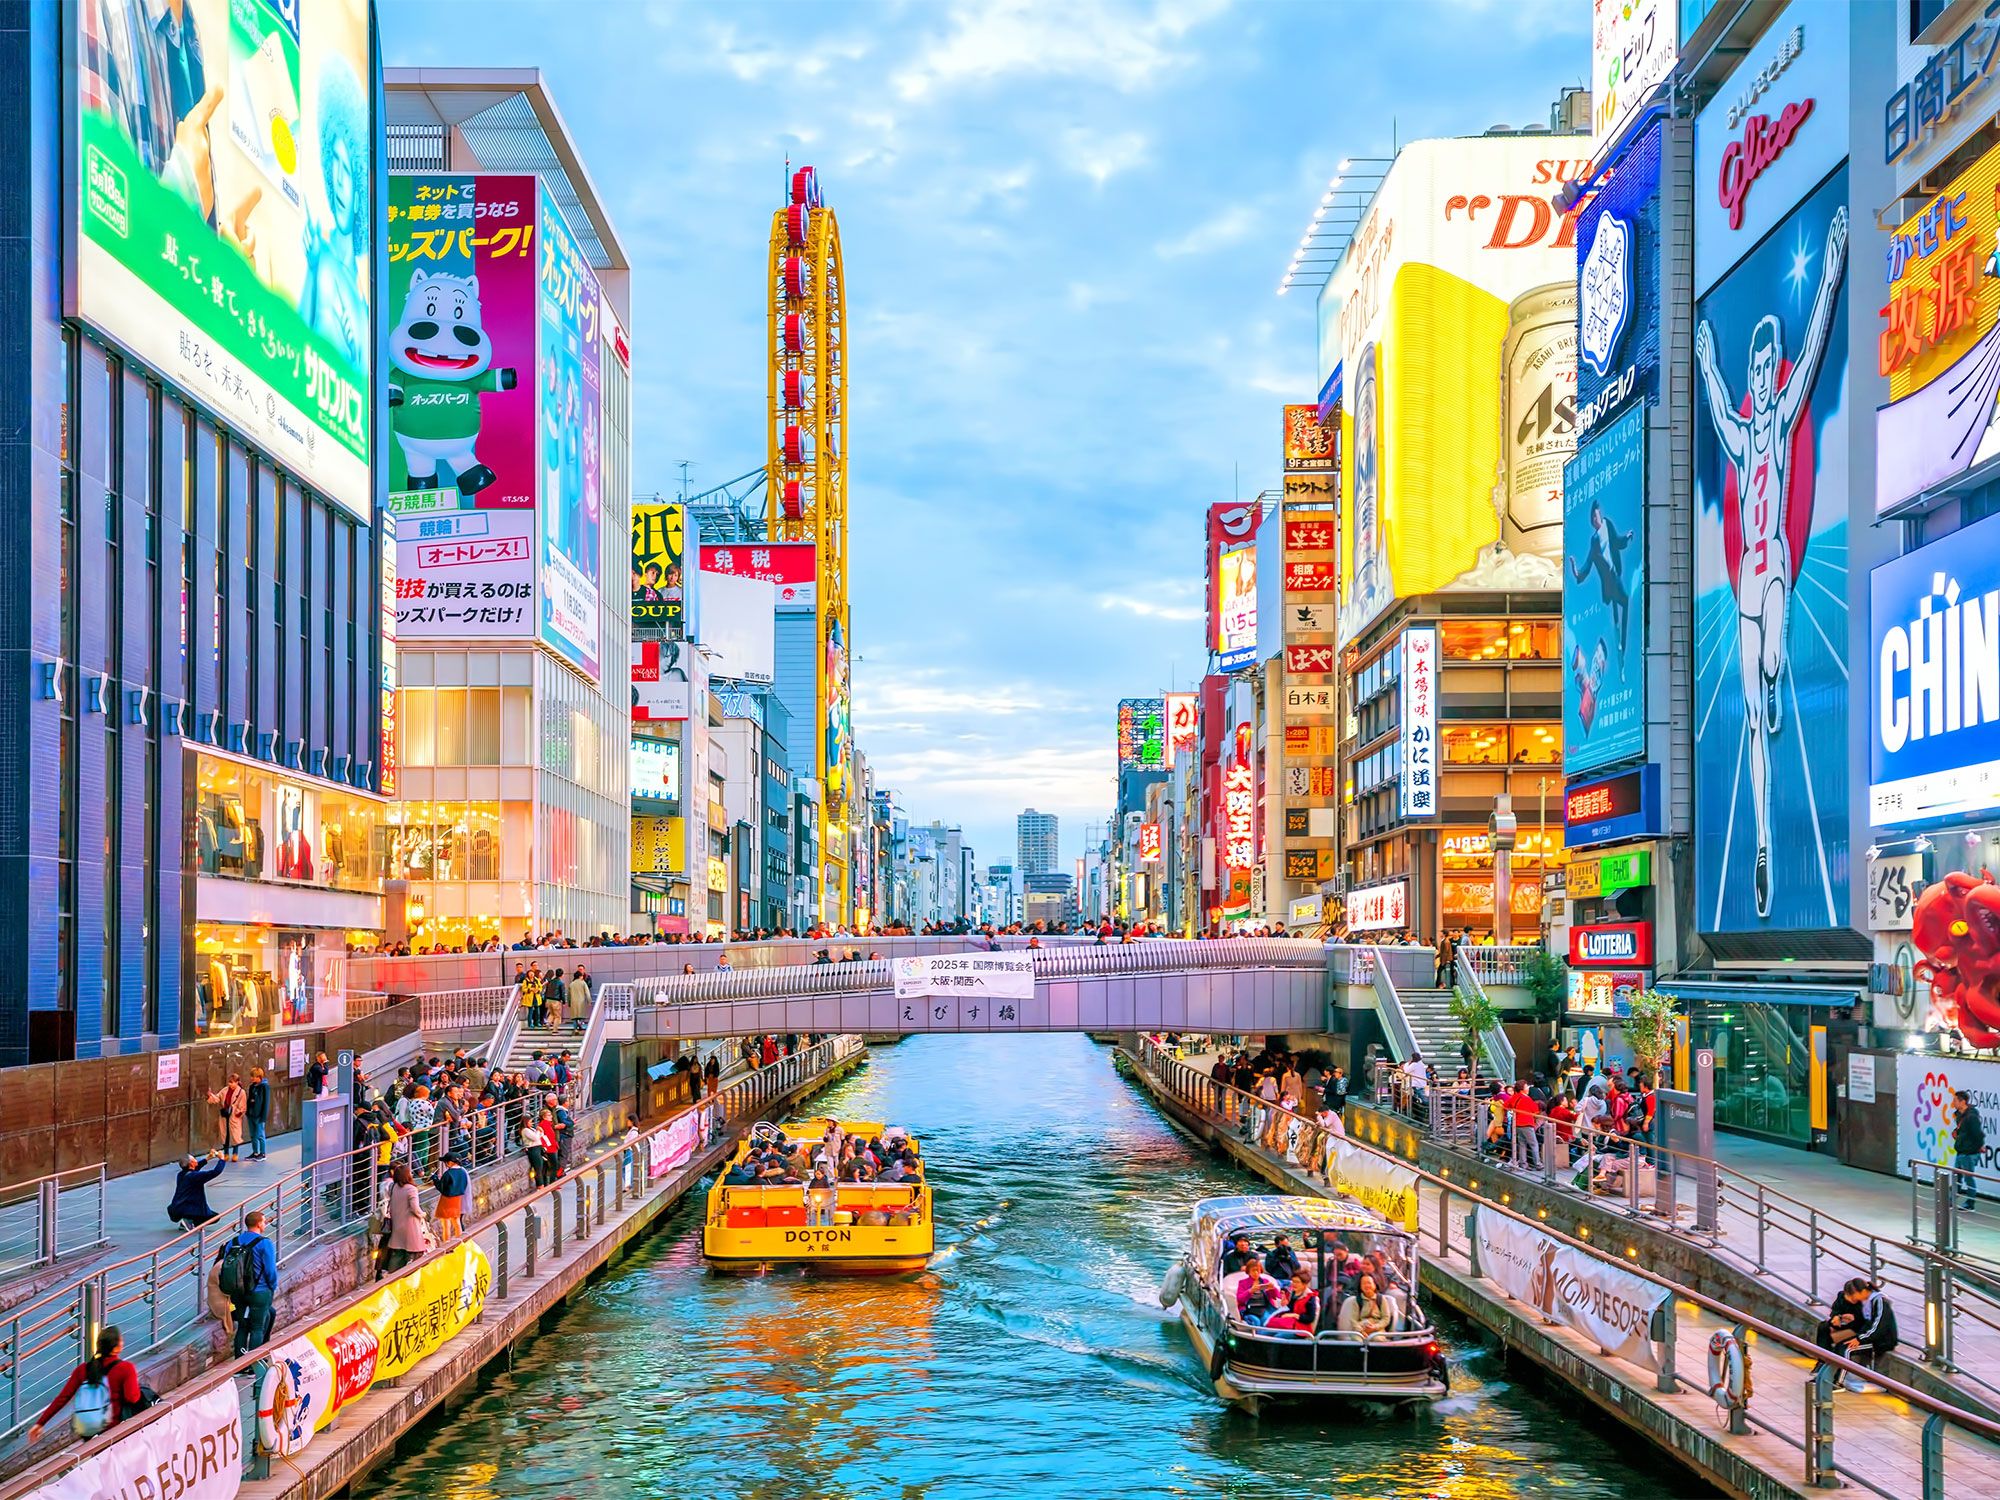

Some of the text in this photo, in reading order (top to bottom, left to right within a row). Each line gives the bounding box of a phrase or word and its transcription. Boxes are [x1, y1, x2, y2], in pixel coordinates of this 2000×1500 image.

[416, 184, 476, 200] ネットで
[388, 225, 534, 261] ッズパーク!
[1887, 191, 1968, 284] かぜに
[1880, 235, 1976, 377] 改源
[304, 344, 365, 443] サロンパス
[411, 393, 469, 405] オッズパーク!
[1289, 458, 1301, 468] 9F
[1753, 455, 1770, 577] グリコ
[419, 518, 461, 537] 競輪!
[428, 542, 519, 563] オートレース!
[1287, 576, 1334, 588] ダイニング
[1289, 690, 1330, 705] 白木屋
[1413, 658, 1430, 718] 本場の味
[1223, 764, 1253, 869] 大阪王将
[1289, 866, 1316, 876] ドンキー
[1589, 933, 1633, 955] LOTTERIA
[930, 960, 1033, 973] 2025年 国際博覧会を
[930, 976, 985, 987] 大阪・関西へ
[903, 1005, 1015, 1021] えびす橋
[785, 1230, 851, 1242] DOTON
[1552, 1267, 1589, 1310] MGM
